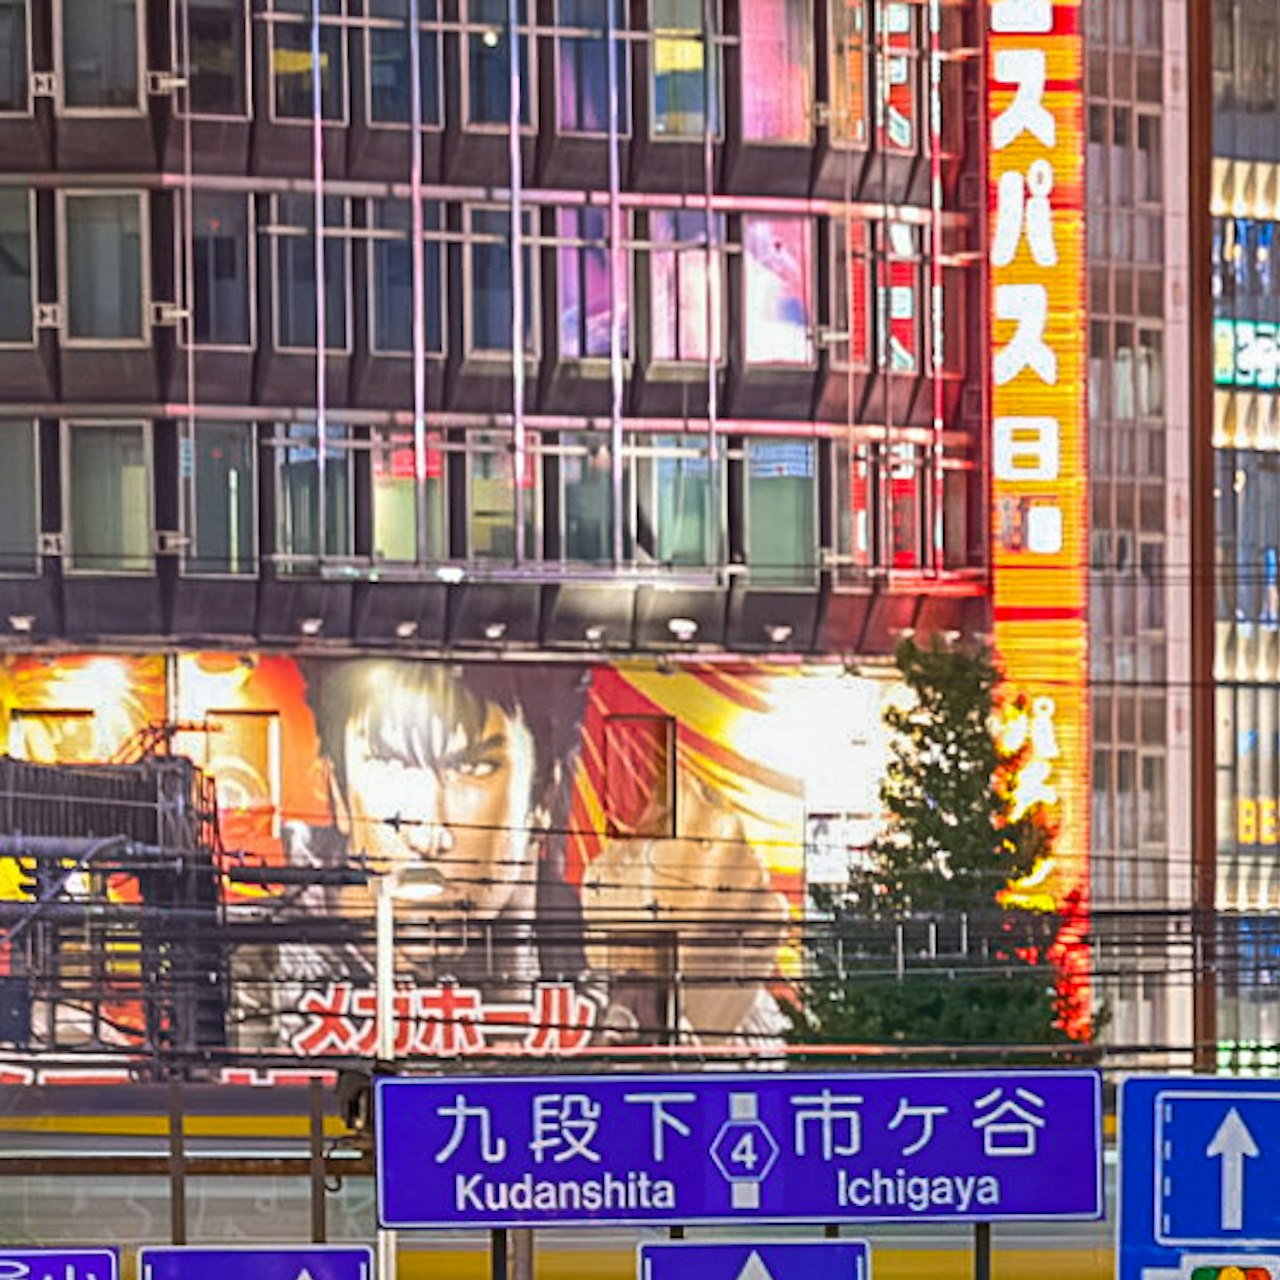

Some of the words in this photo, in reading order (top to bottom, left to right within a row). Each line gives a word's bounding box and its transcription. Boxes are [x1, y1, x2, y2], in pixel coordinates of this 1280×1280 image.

[293, 980, 599, 1058] メガホール
[435, 1092, 697, 1164] 九段下
[730, 1131, 758, 1170] 4
[455, 1173, 676, 1212] Kudanshita
[837, 1169, 999, 1210] Ichigaya
